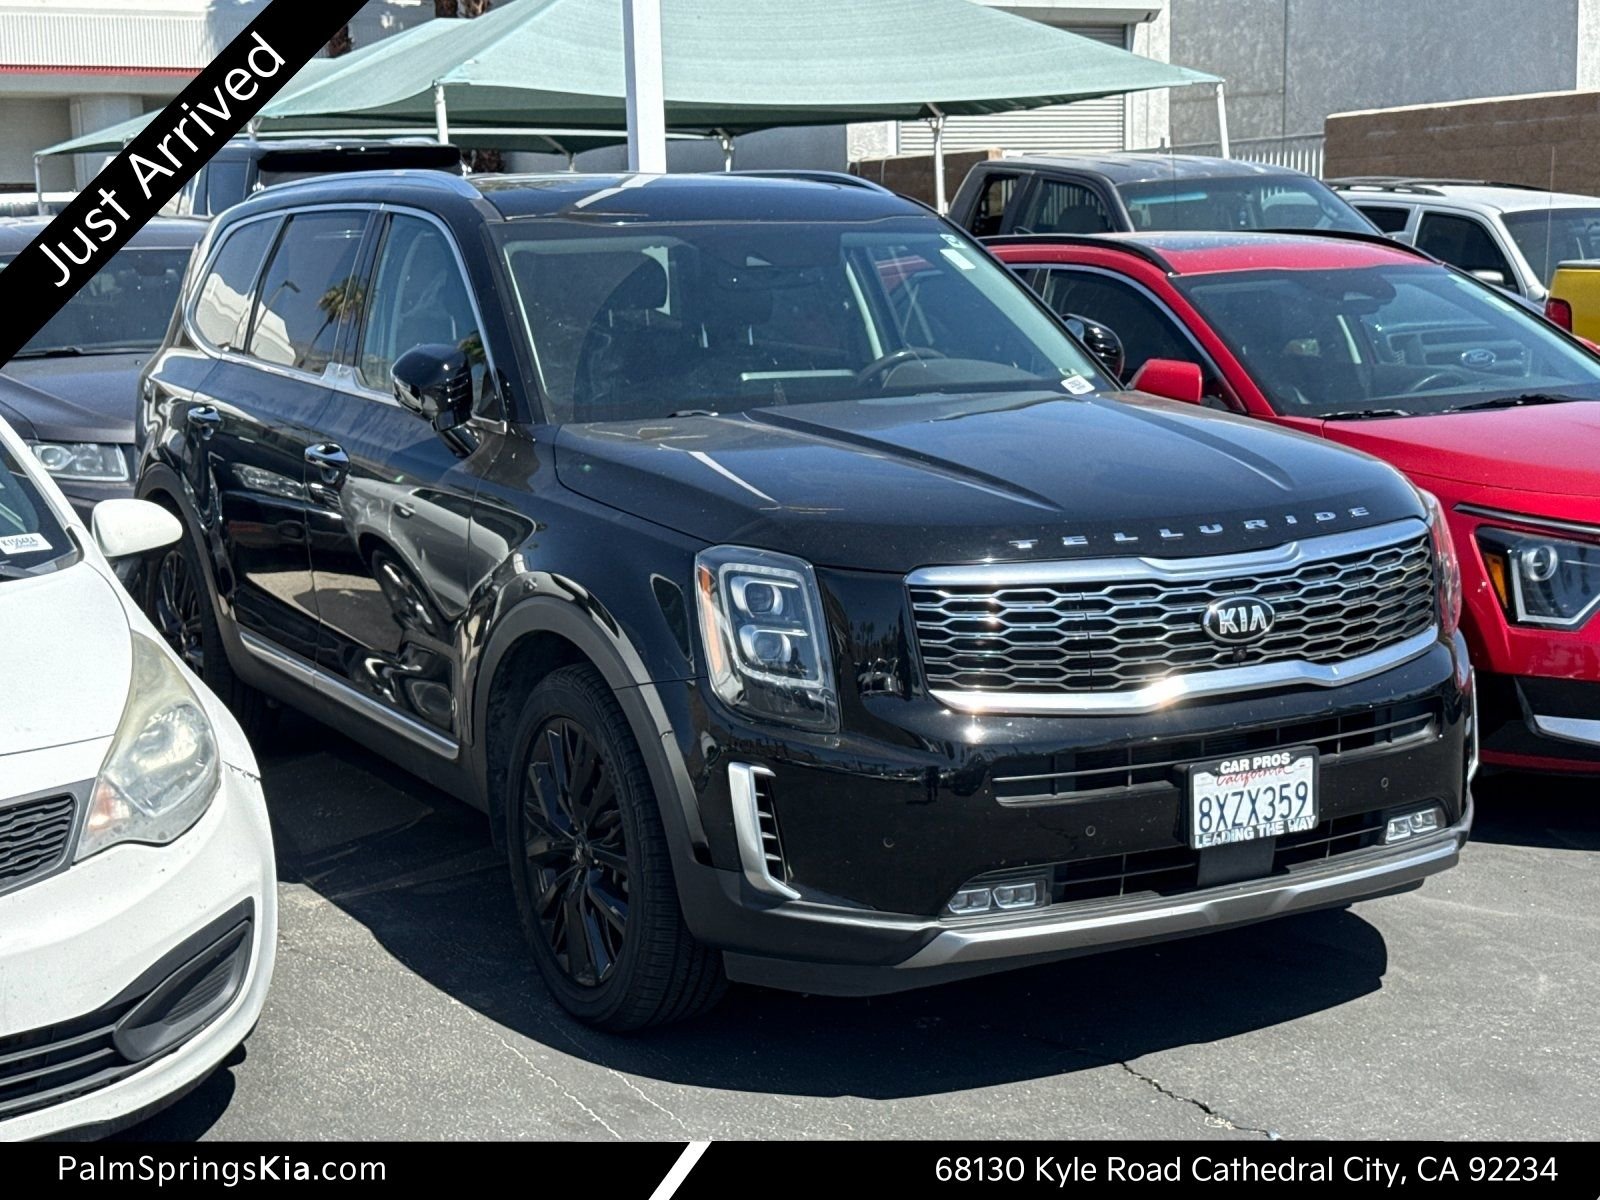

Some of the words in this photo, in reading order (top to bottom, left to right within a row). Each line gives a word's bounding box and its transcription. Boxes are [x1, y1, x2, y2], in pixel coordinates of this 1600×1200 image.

[1007, 506, 1371, 550] TELLURIDE
[1217, 605, 1267, 634] KIA
[1220, 759, 1250, 774] CAR
[1252, 752, 1291, 770] PROS
[1198, 780, 1308, 833] 8XZX359
[1194, 824, 1255, 849] LEADING
[1257, 819, 1285, 838] THE
[1286, 815, 1316, 833] WAY
